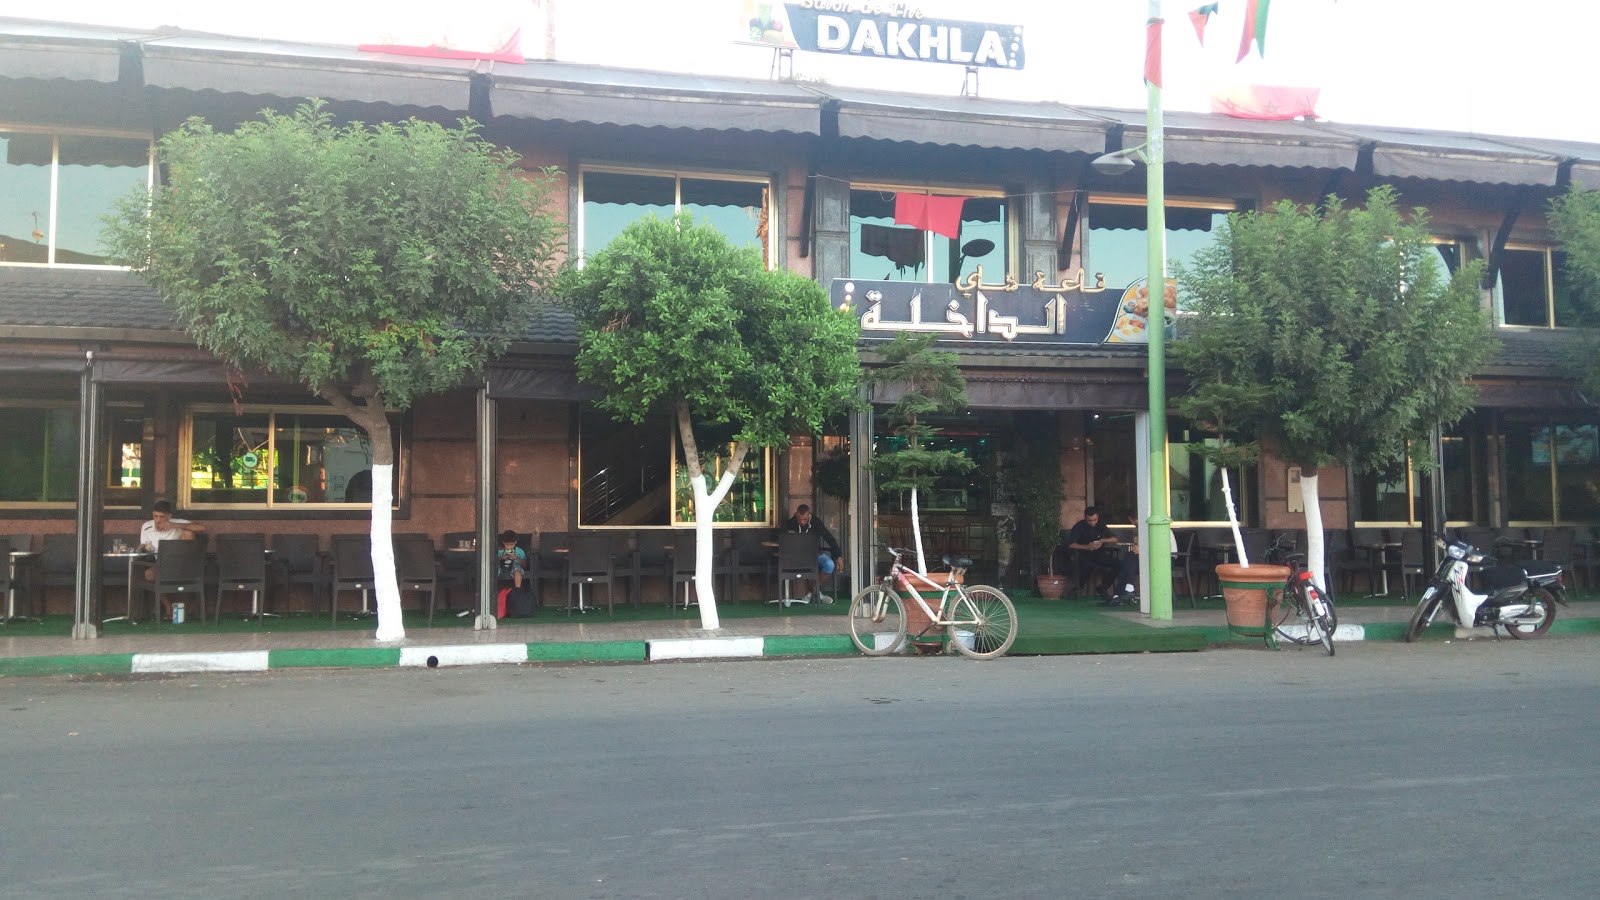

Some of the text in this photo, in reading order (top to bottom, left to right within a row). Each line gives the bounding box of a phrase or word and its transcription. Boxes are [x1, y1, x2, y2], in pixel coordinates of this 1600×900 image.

[817, 14, 1008, 66] DAKHLA
[954, 263, 1107, 298] قاعة شاي
[860, 289, 1068, 342] الداخلة
